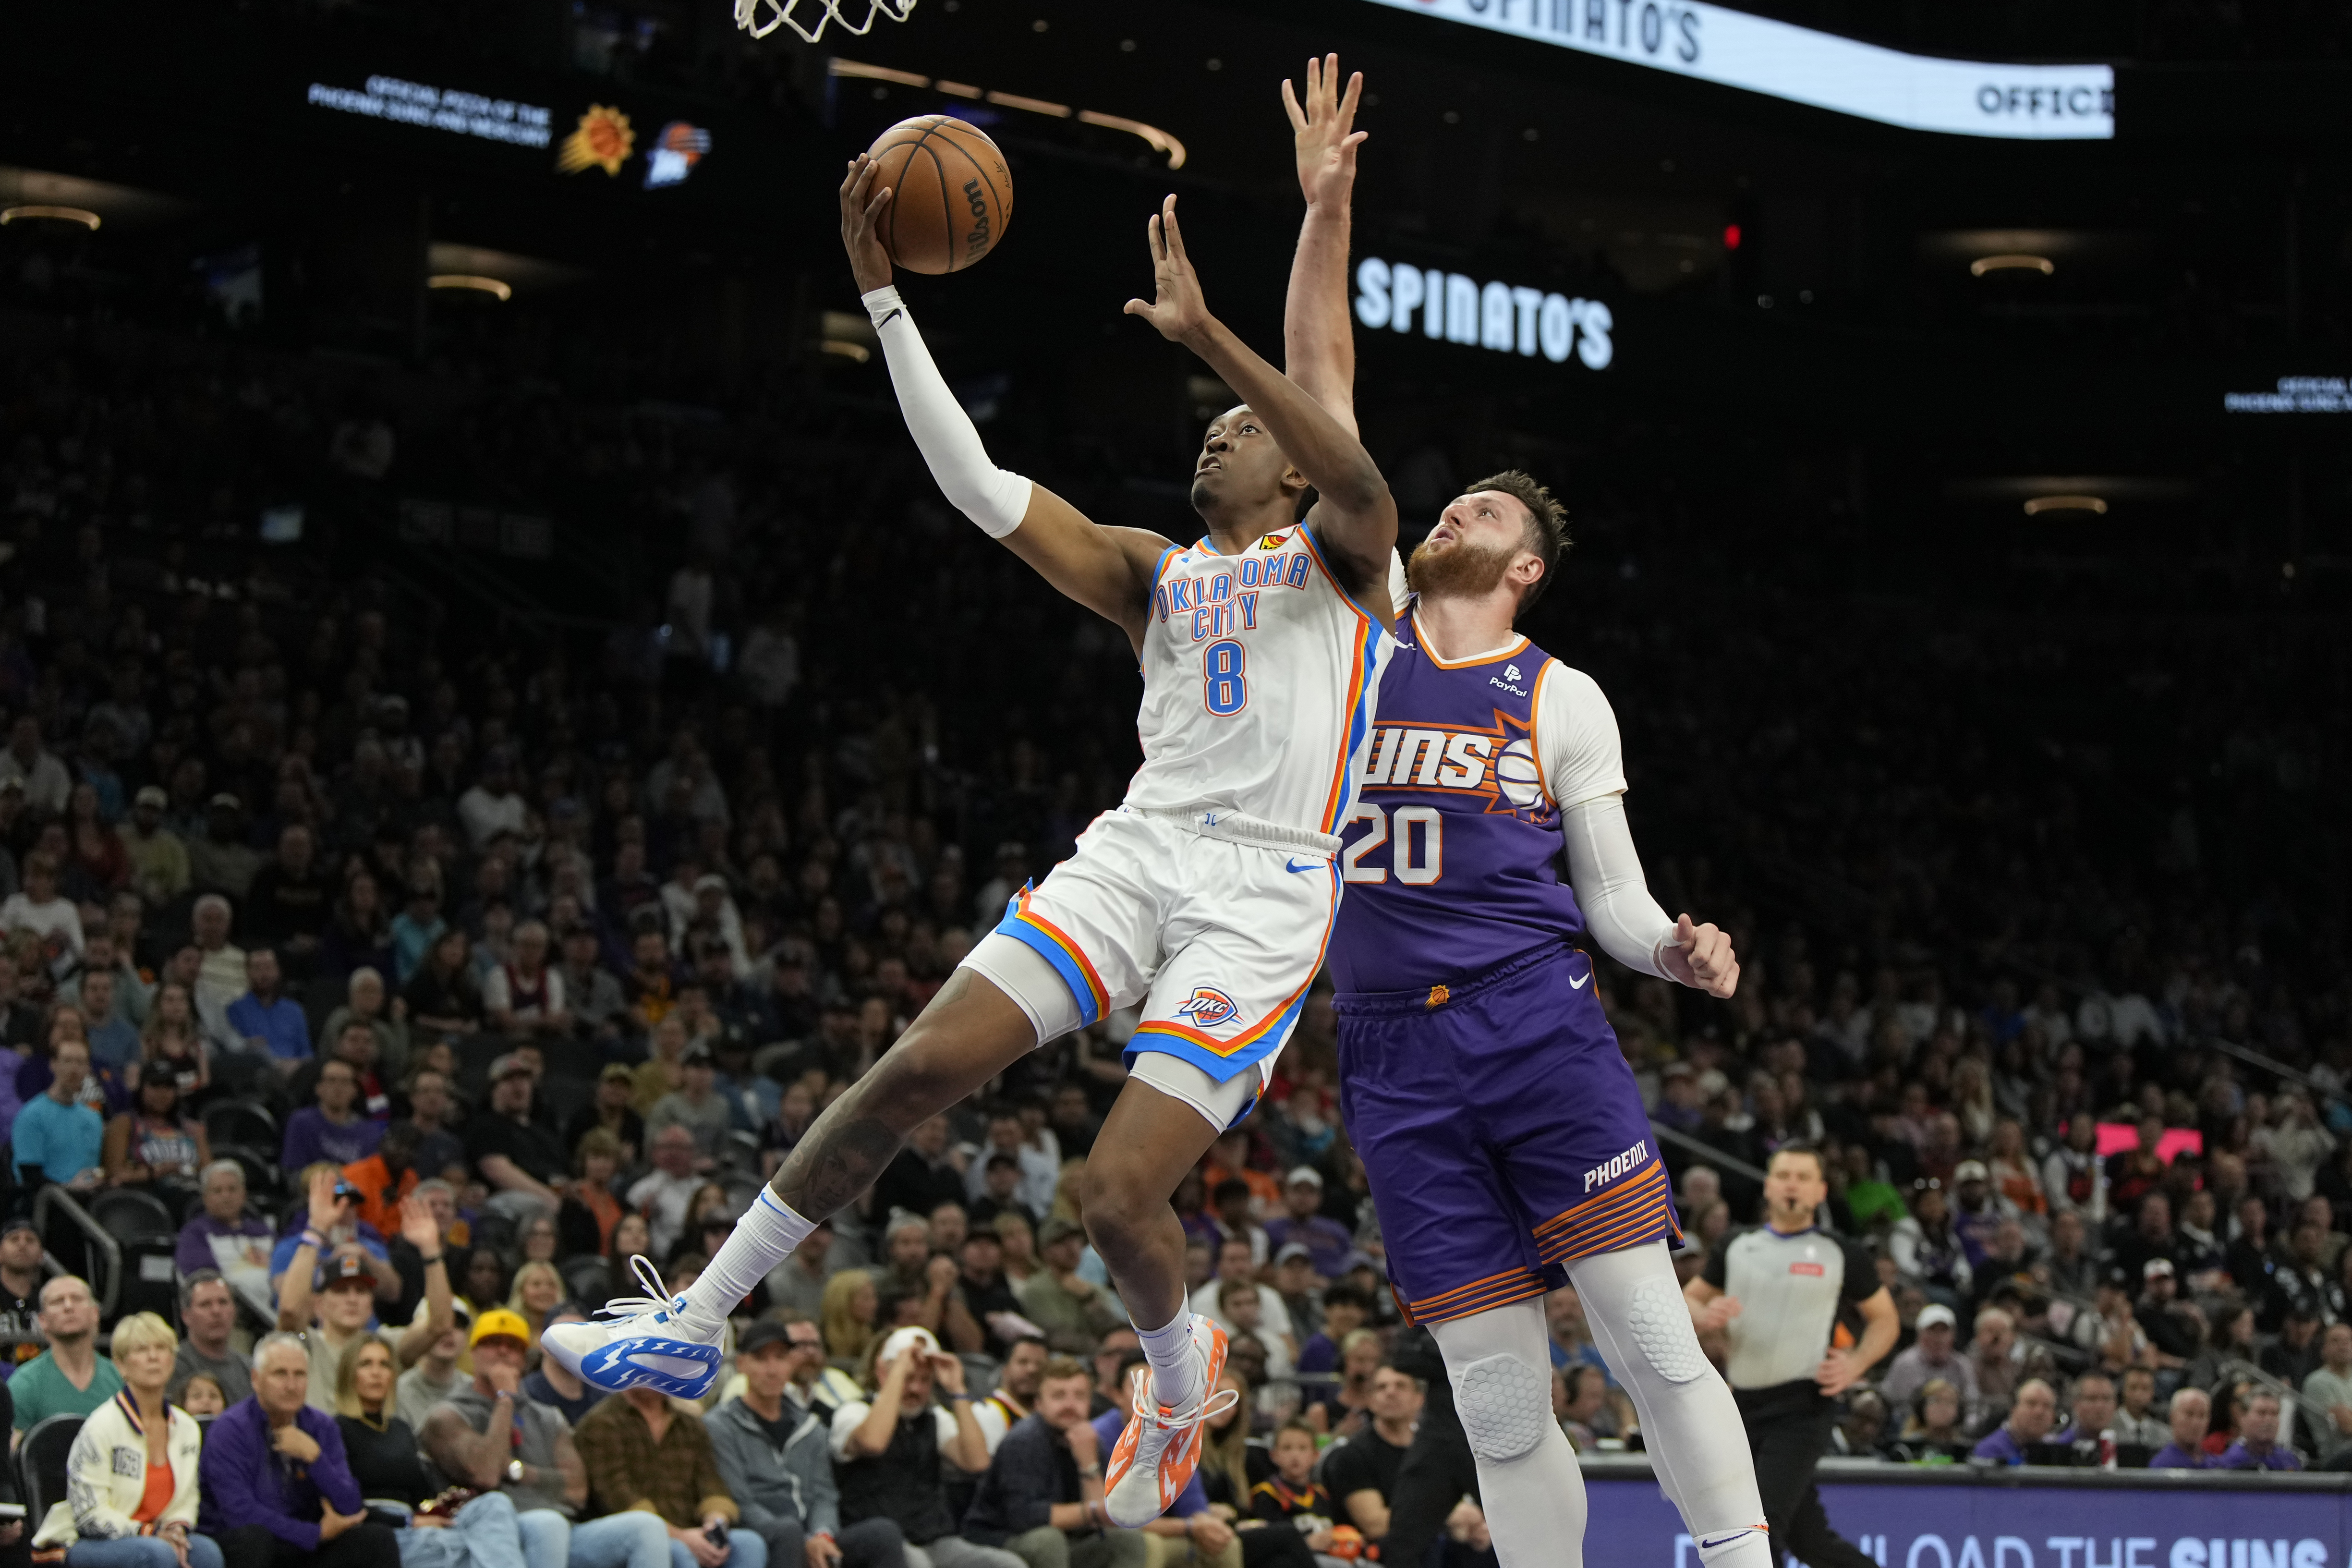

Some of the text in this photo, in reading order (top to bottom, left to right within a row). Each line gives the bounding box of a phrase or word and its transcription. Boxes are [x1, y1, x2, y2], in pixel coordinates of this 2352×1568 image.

[1469, 0, 1701, 63] INATO'S
[1354, 256, 1614, 371] SPINATO'S
[1155, 552, 1313, 623] OKLAOMA
[1191, 590, 1260, 642] CITY
[1203, 639, 1248, 717] 8
[1489, 676, 1528, 697] PayPal
[1362, 728, 1492, 789] UNS
[1343, 802, 1443, 886] 20
[1584, 1139, 1649, 1194] PHOENIX
